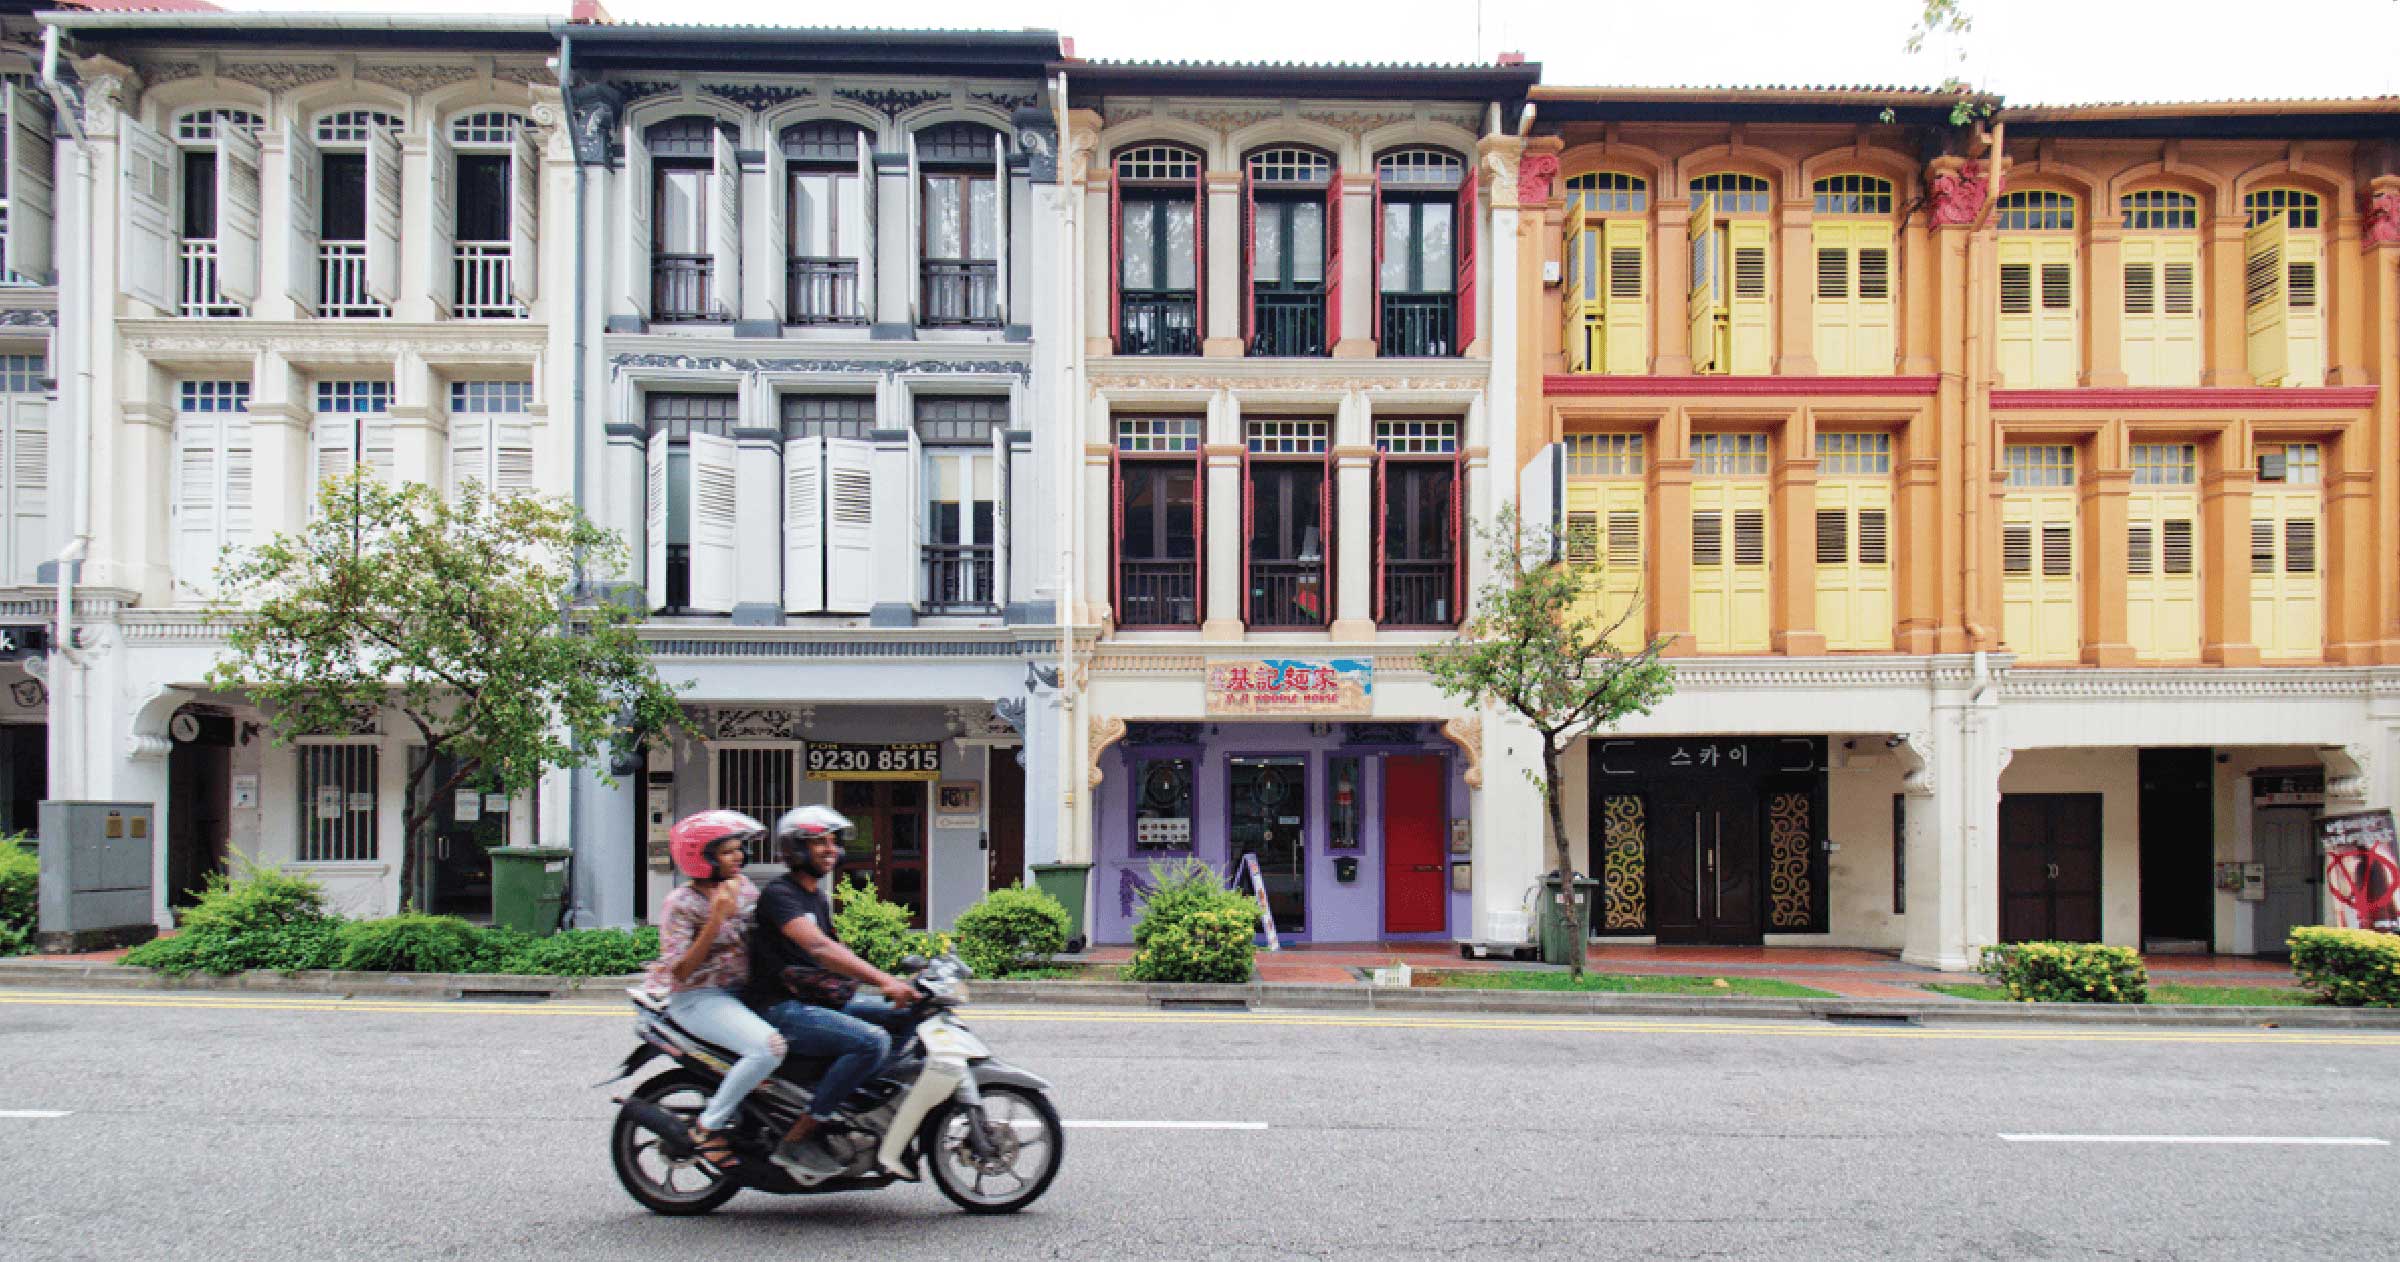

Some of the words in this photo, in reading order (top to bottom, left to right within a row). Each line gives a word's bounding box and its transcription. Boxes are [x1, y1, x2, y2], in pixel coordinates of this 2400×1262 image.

[810, 750, 870, 770] 9230
[877, 750, 937, 770] 8515
[1670, 744, 1748, 768] 스카이
